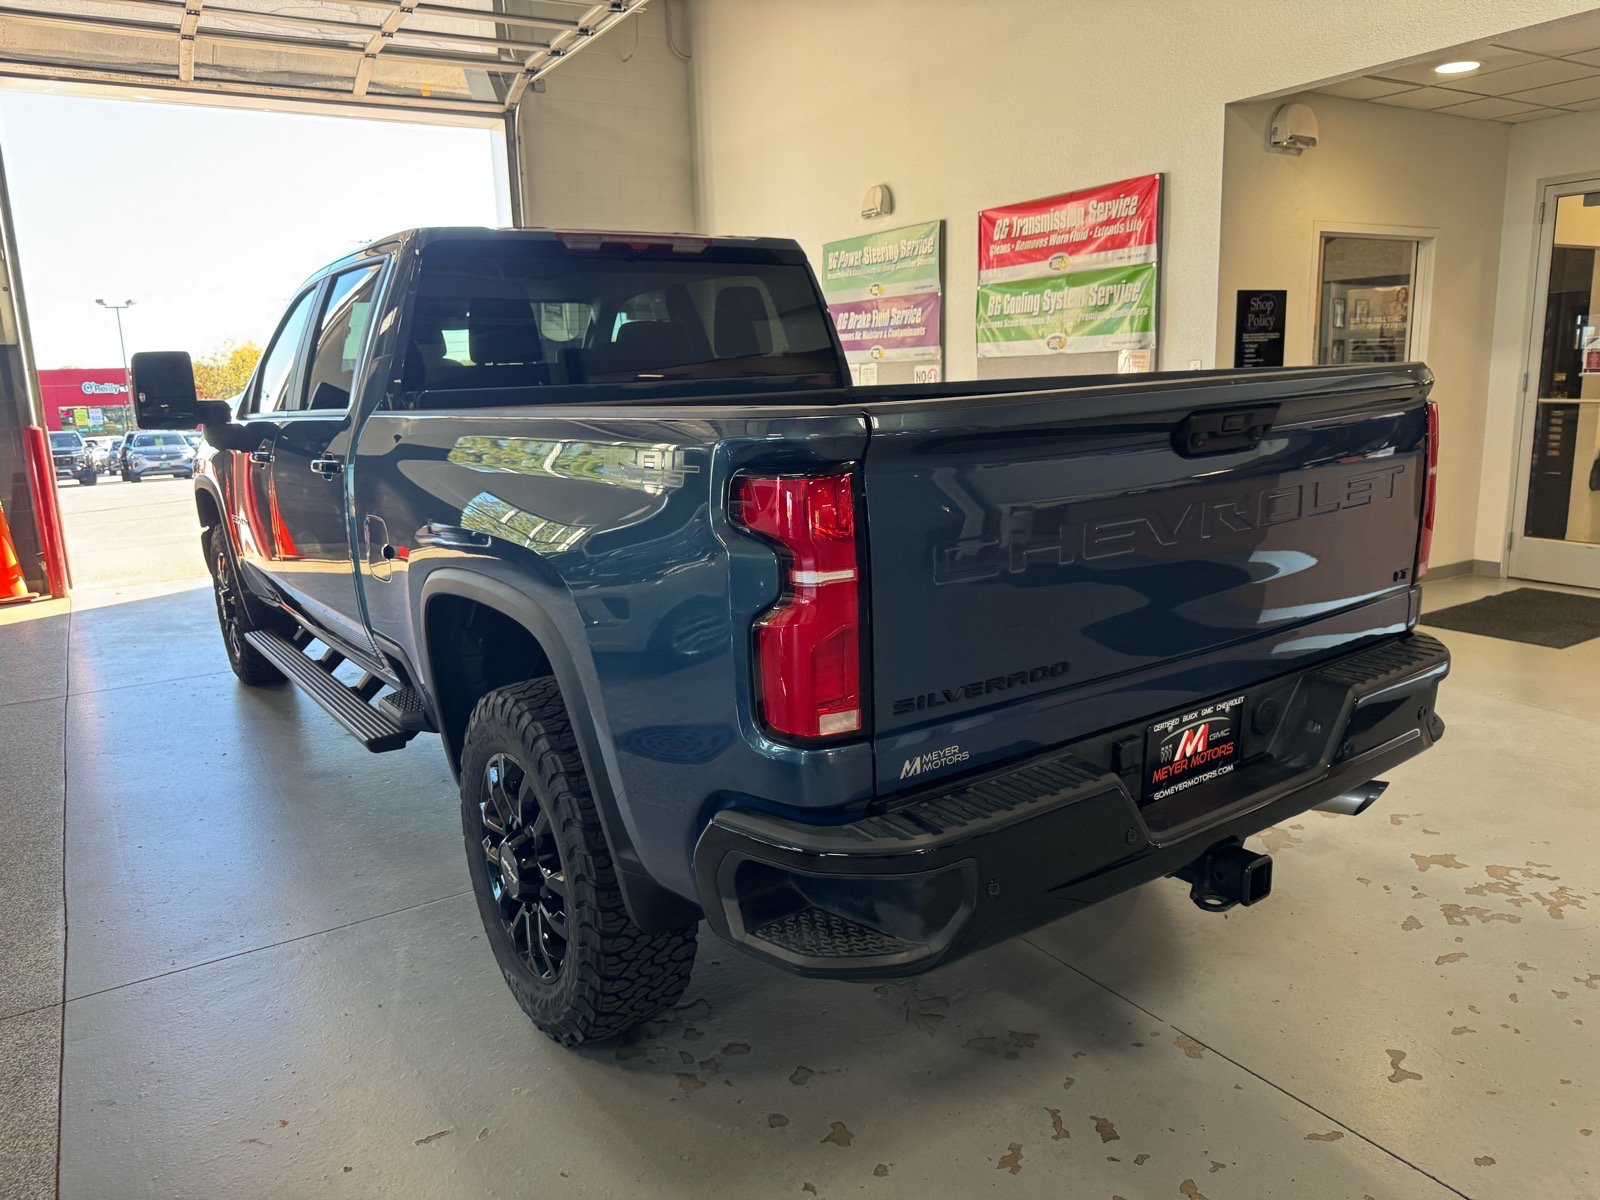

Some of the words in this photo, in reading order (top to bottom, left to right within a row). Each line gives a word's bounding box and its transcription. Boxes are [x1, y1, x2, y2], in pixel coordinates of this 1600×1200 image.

[993, 218, 1010, 241] BG
[1011, 205, 1086, 239] Transmission
[1088, 194, 1139, 225] Service
[1015, 236, 1048, 251] Removes
[1049, 233, 1068, 246] Worn
[1068, 229, 1089, 244] Fluid
[1094, 221, 1125, 238] Extends
[828, 251, 839, 270] BG
[838, 249, 862, 270] Power
[862, 243, 899, 266] Steering
[900, 236, 935, 259] Service
[987, 295, 1002, 317] BG
[1003, 292, 1041, 317] Cooling
[1042, 286, 1086, 315] System
[1089, 280, 1142, 307] Service
[1250, 297, 1274, 314] Shop
[837, 312, 848, 331] BG
[847, 310, 871, 330] Brake
[871, 308, 890, 328] Fluid
[890, 305, 922, 326] Service
[1248, 314, 1275, 331] Policy
[888, 327, 926, 339] Contaminants
[83, 382, 120, 394] O'Reilly
[915, 371, 926, 382] NO
[933, 464, 1406, 586] CHEVROLET
[893, 661, 1070, 715] SILVERADO
[1153, 717, 1180, 732] CERTIFIED
[1182, 711, 1199, 723] BUICK
[1201, 706, 1214, 716] GMC
[1216, 696, 1245, 711] CHEVROLET
[1209, 728, 1231, 741] GMC
[922, 745, 959, 763] MEYER
[922, 751, 970, 773] MOTORS
[1152, 759, 1188, 784] MEYER
[1190, 742, 1234, 768] MOTORS
[1153, 764, 1234, 800] GOMEYERMOTORS.COM
